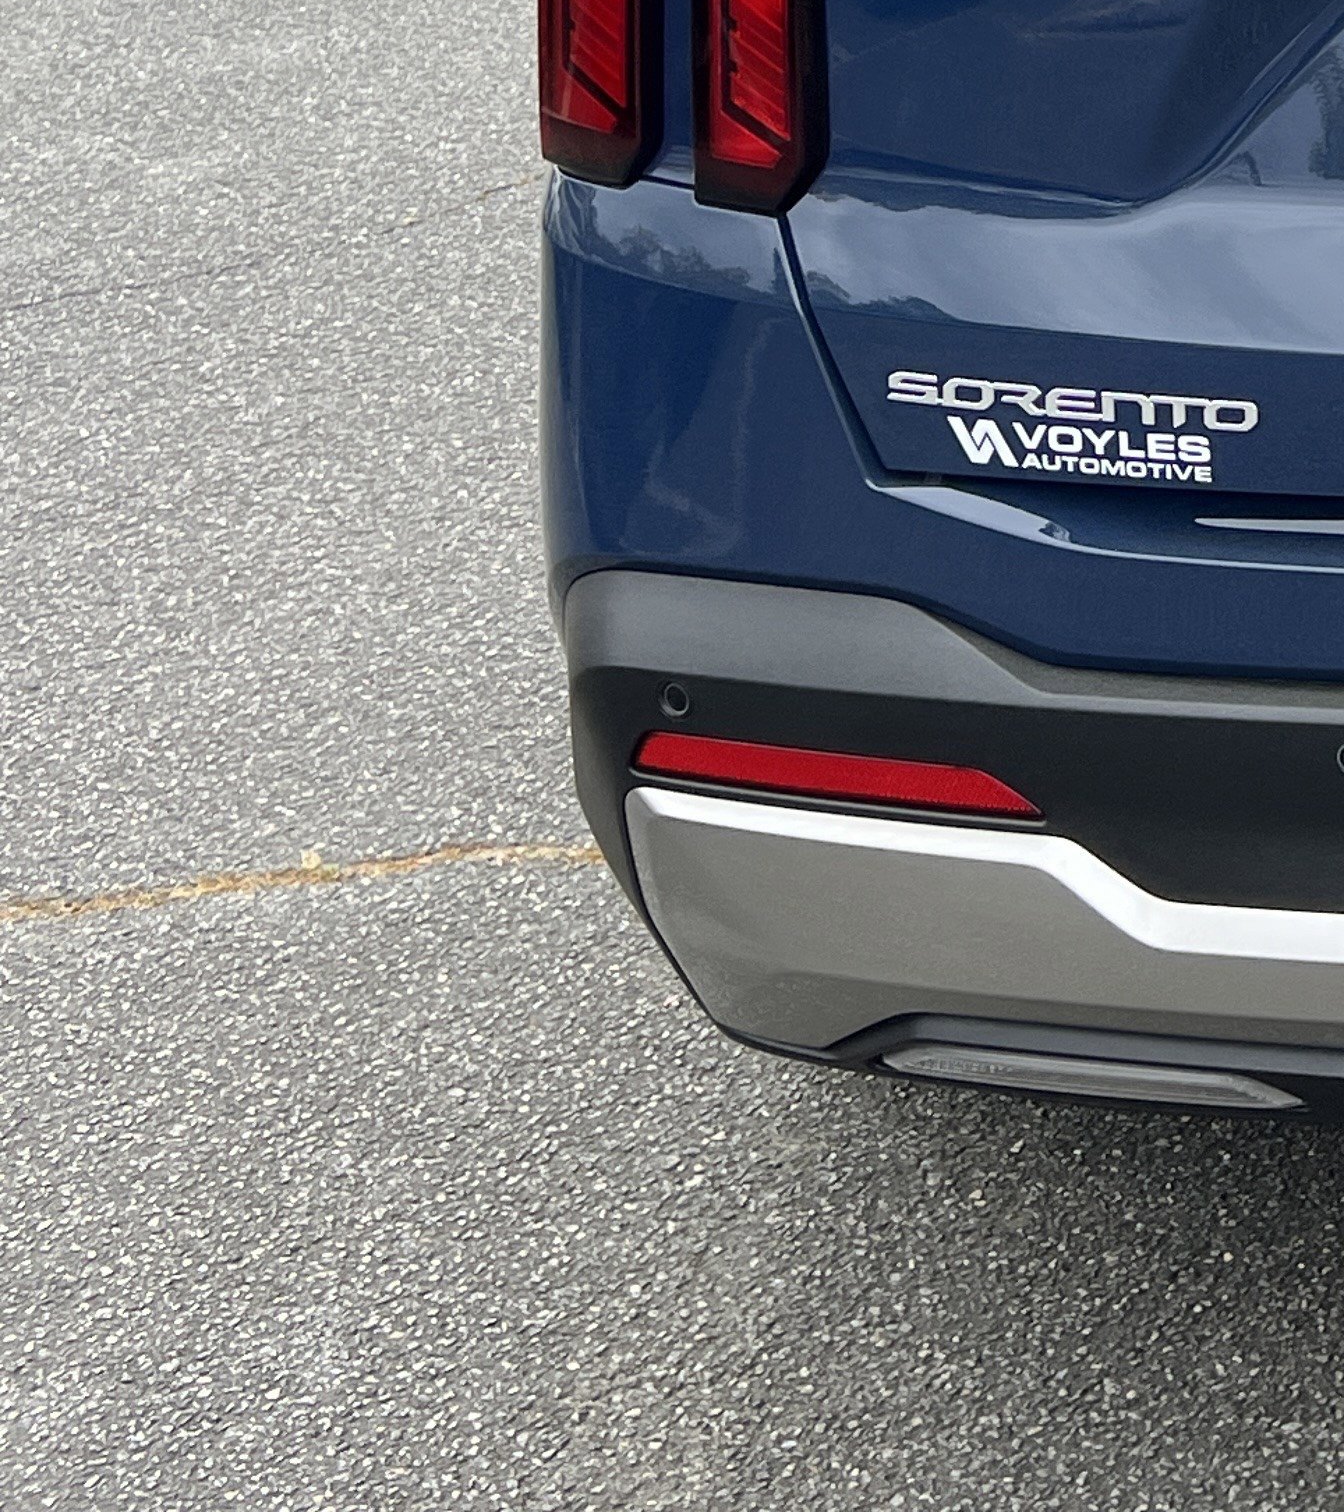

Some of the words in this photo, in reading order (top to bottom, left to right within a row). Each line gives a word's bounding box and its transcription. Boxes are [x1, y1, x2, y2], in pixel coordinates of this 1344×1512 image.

[887, 370, 1259, 432] SORENTO
[1012, 421, 1212, 463] VOYLES
[1020, 453, 1212, 483] AUTOMOTIVE
